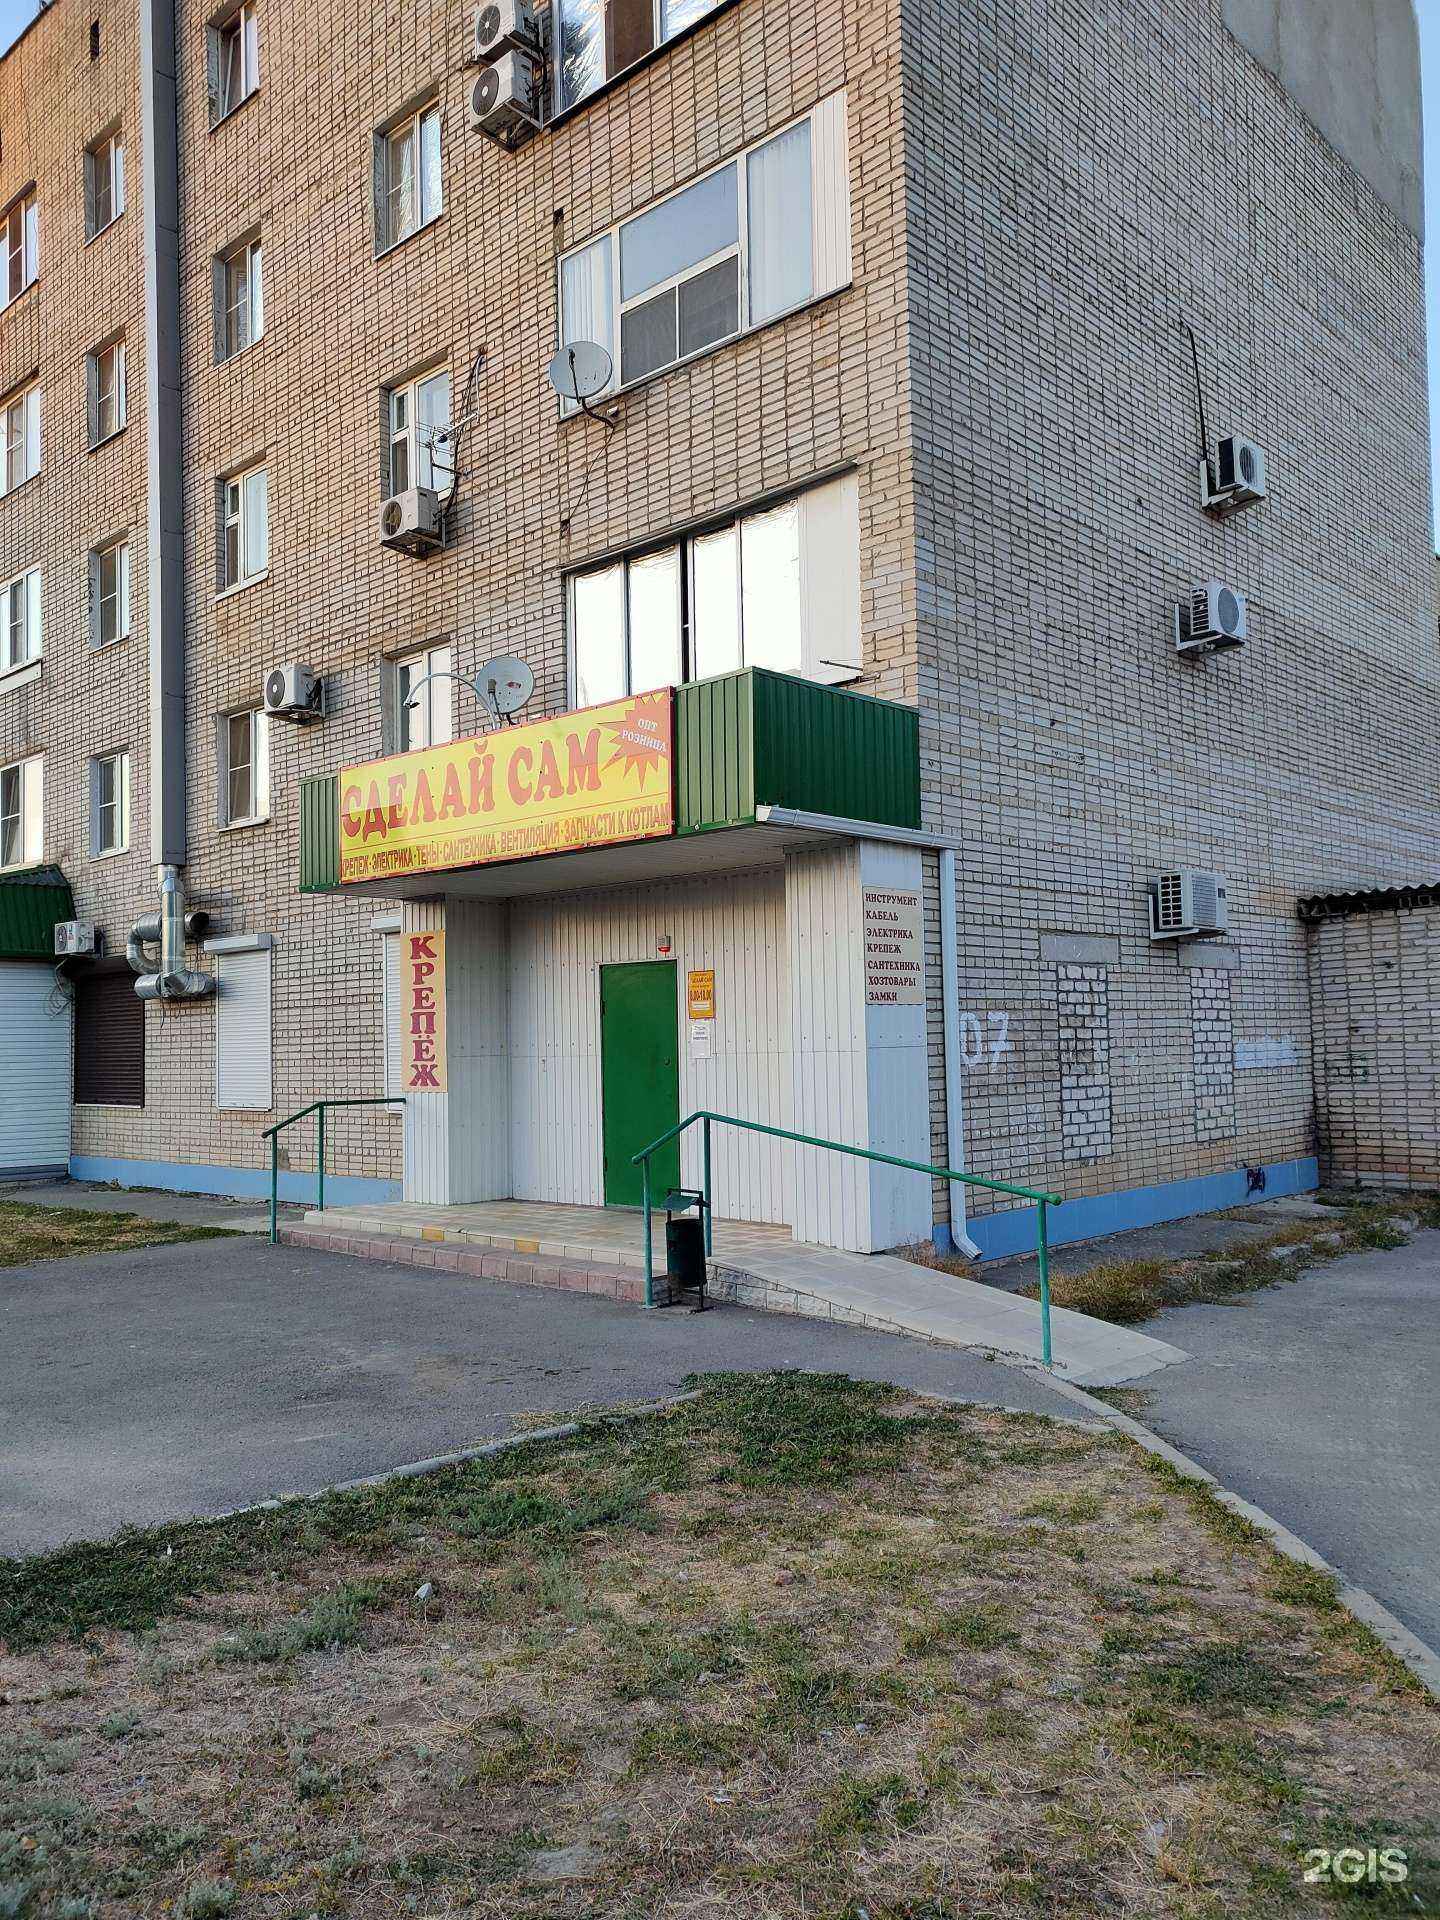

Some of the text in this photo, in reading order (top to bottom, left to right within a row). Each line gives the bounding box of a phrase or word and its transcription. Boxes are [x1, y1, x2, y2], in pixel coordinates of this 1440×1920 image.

[622, 729, 667, 753] РОЗНИЦА
[341, 728, 602, 842] СДЕЛАЙ САМ
[372, 847, 413, 872] ЭЛЕКТРИКА
[416, 841, 440, 865] ТЕНЫ
[443, 833, 497, 860] САНТЕХНИКА
[500, 820, 560, 852] ВЕНТИЛЯЦИЯ
[564, 811, 617, 842] ЗАПЧАСТИ
[618, 809, 625, 834] К
[865, 893, 918, 906] ИНСТРУМЕНТ
[865, 910, 899, 921] КАБЕЛЬ
[866, 928, 914, 939] ЭЛЕКТРИКА
[867, 943, 902, 954] КРЕПЕЖ
[868, 960, 921, 971] САНТЕХНИКА
[868, 976, 917, 987] ХОЗТОВАРЫ
[869, 992, 898, 1001] ЗАМКИ
